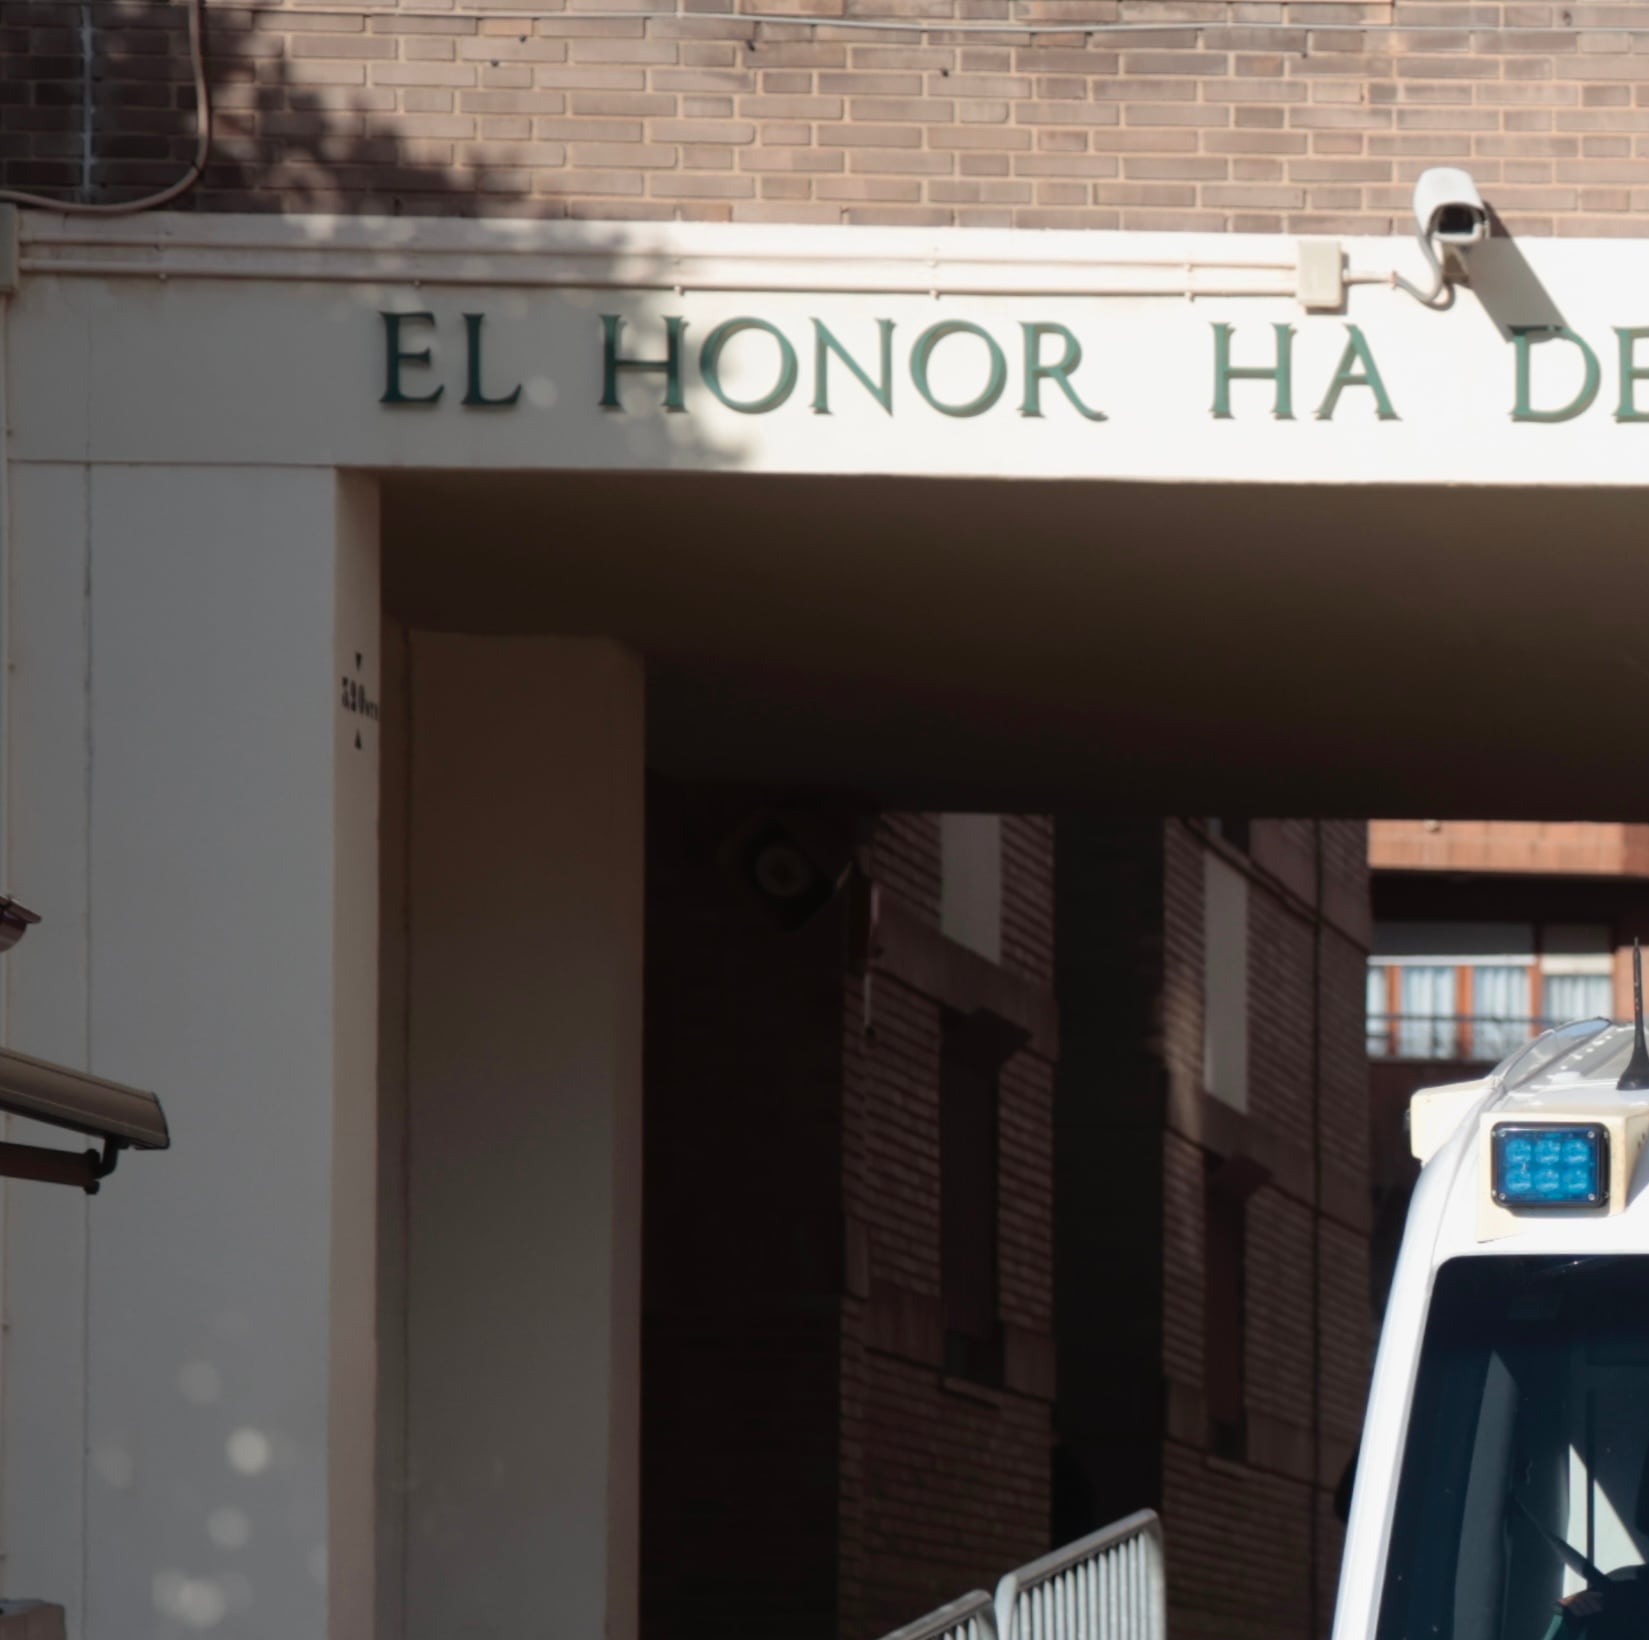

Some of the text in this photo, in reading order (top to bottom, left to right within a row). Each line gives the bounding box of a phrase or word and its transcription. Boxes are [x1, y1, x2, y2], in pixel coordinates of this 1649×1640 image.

[379, 311, 522, 409] EL
[599, 314, 1109, 423] HONOR
[1207, 321, 1400, 423] HA
